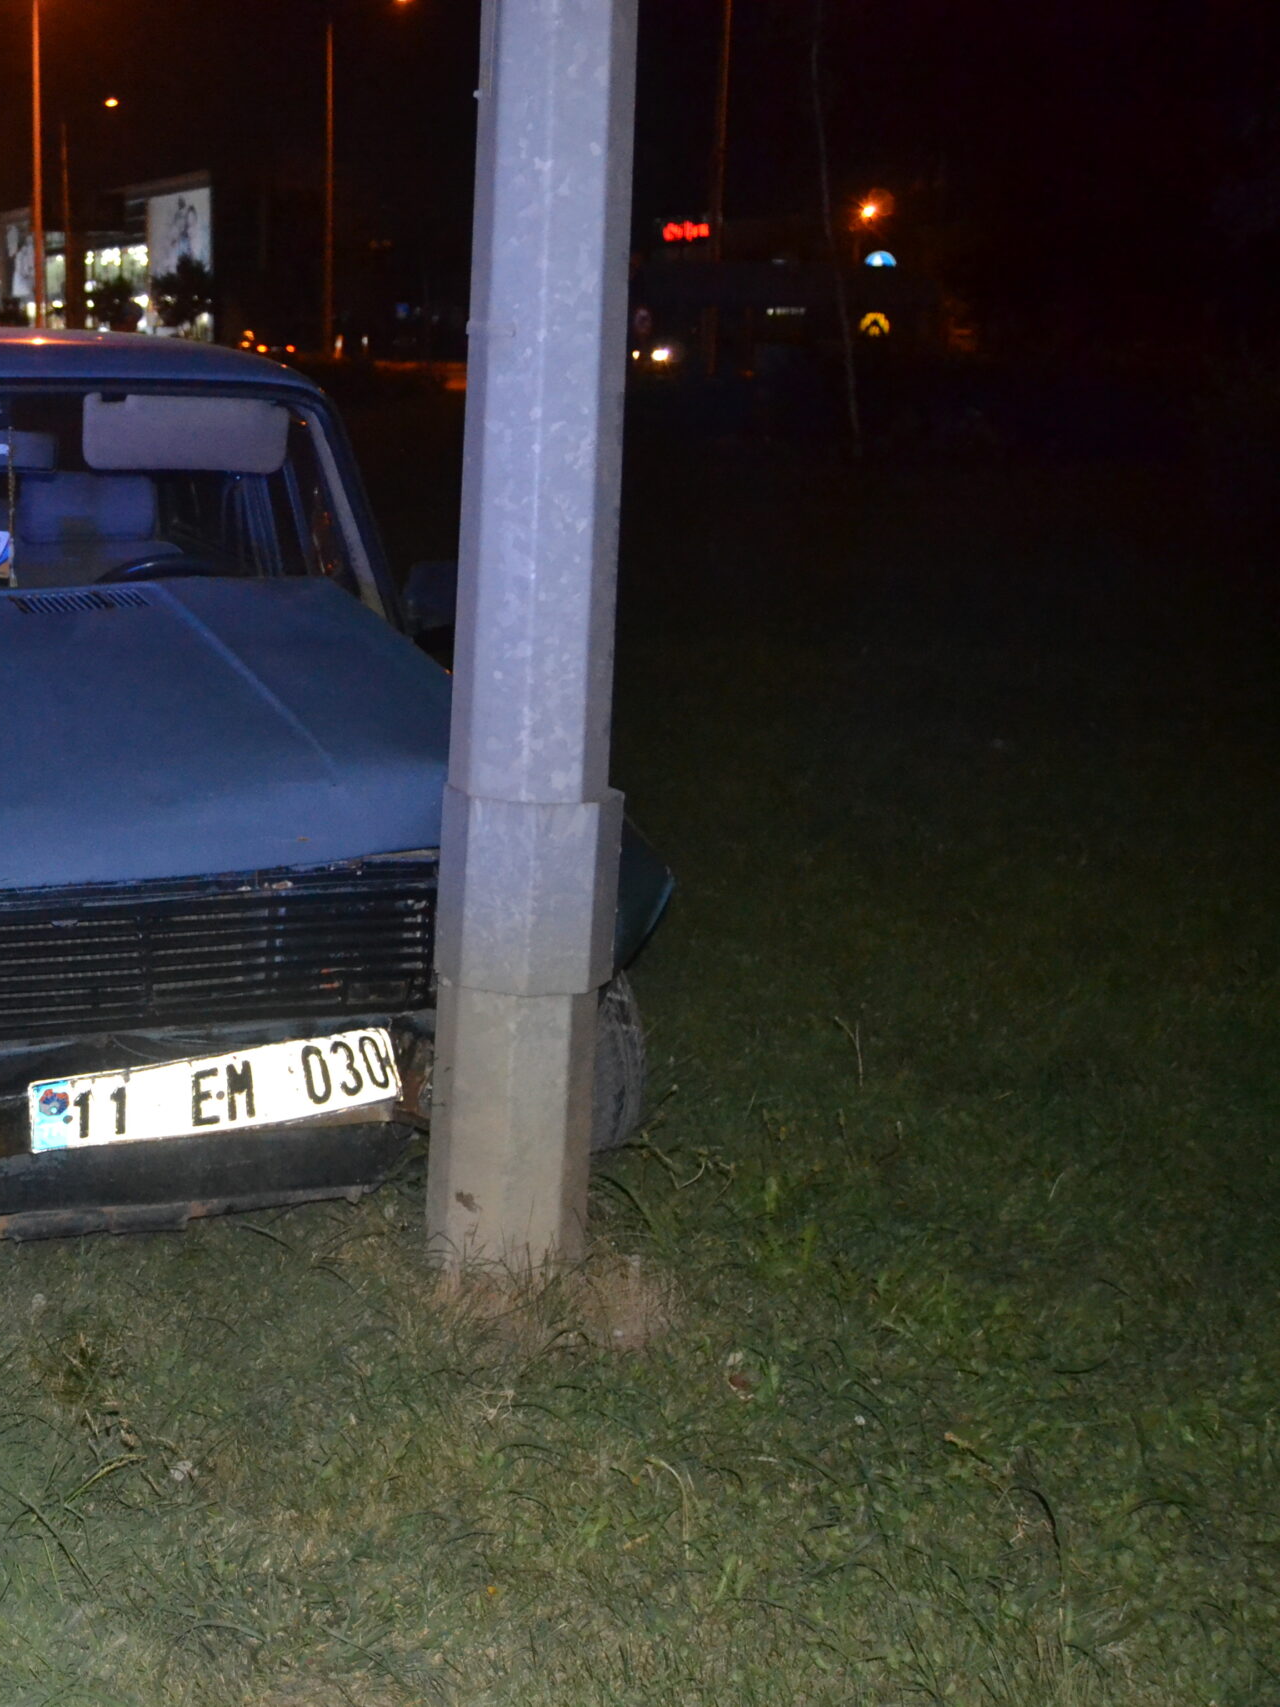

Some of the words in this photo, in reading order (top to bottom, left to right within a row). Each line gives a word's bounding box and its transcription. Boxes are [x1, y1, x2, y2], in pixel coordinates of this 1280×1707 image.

[73, 1086, 126, 1138] 11
[192, 1060, 256, 1127] EM
[301, 1035, 389, 1105] 030
